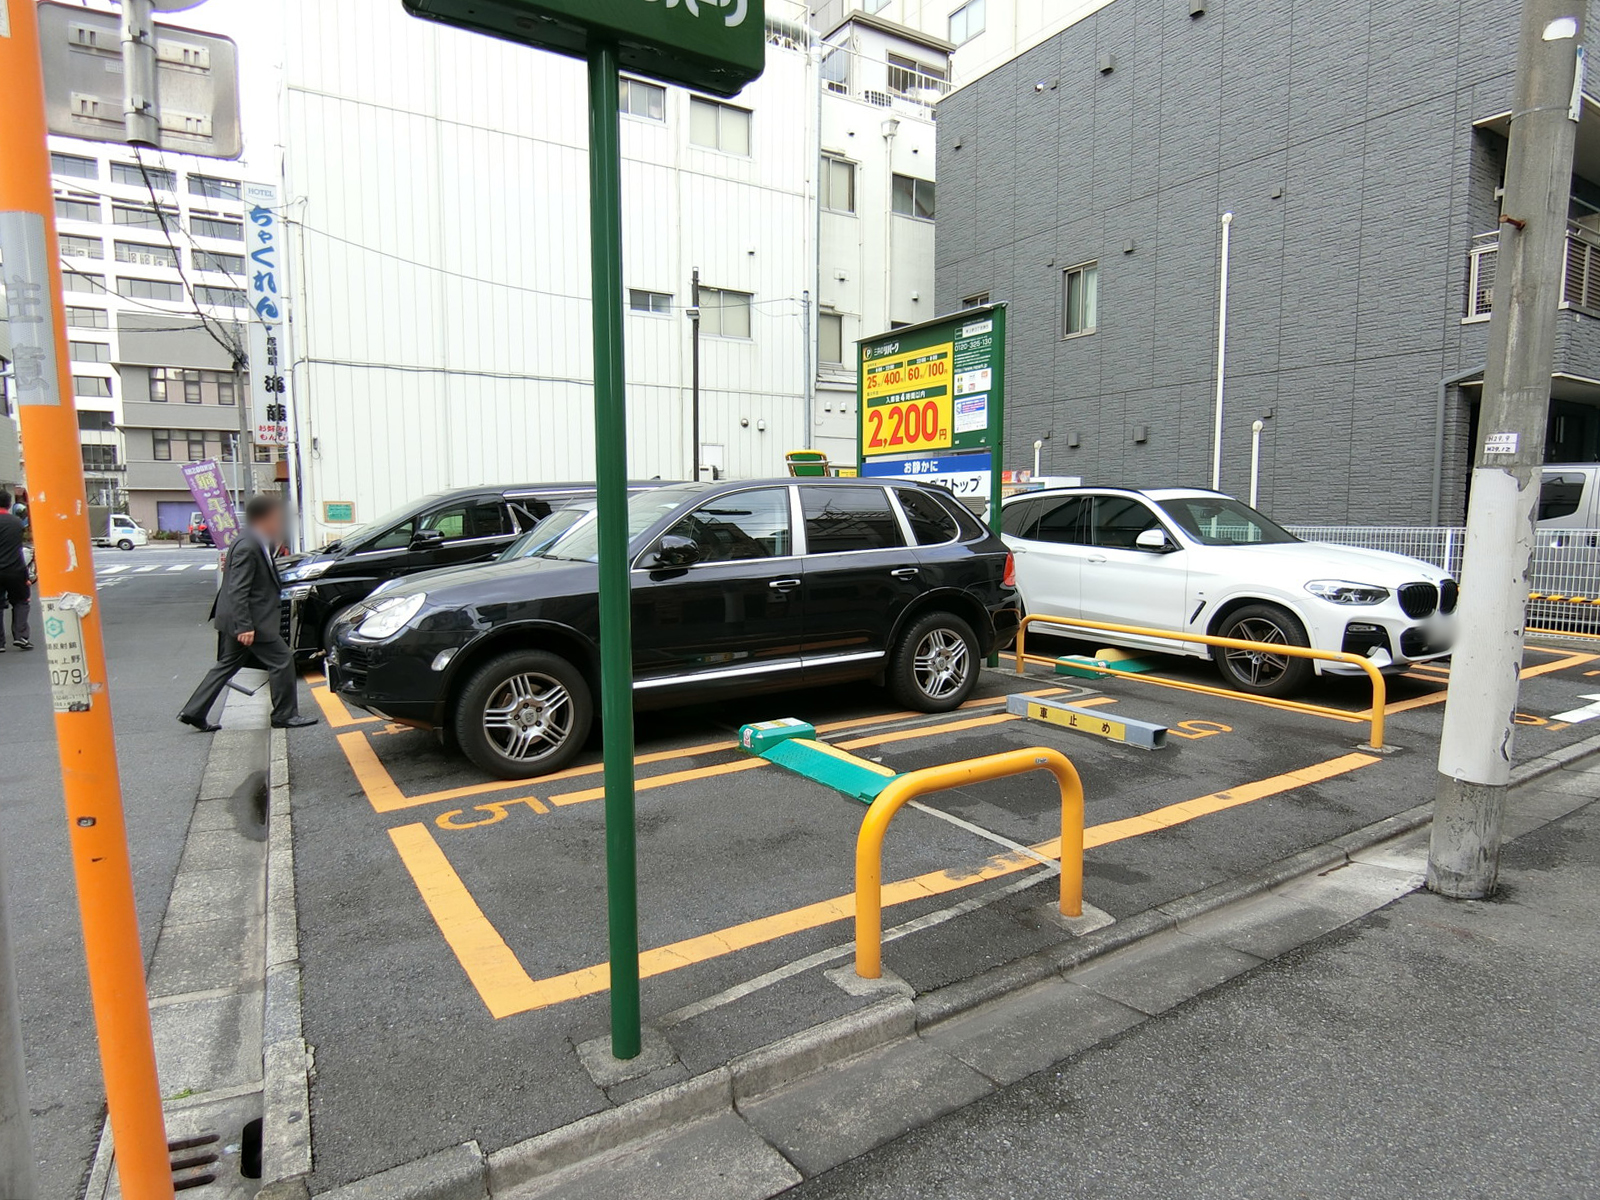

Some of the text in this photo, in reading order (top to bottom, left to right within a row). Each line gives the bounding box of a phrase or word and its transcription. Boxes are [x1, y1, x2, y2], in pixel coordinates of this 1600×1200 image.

[248, 187, 274, 198] HOTEL
[868, 400, 947, 448] 2,200円
[903, 460, 938, 474] お静かに
[61, 654, 81, 664] 上野
[1039, 706, 1111, 734] 車止め
